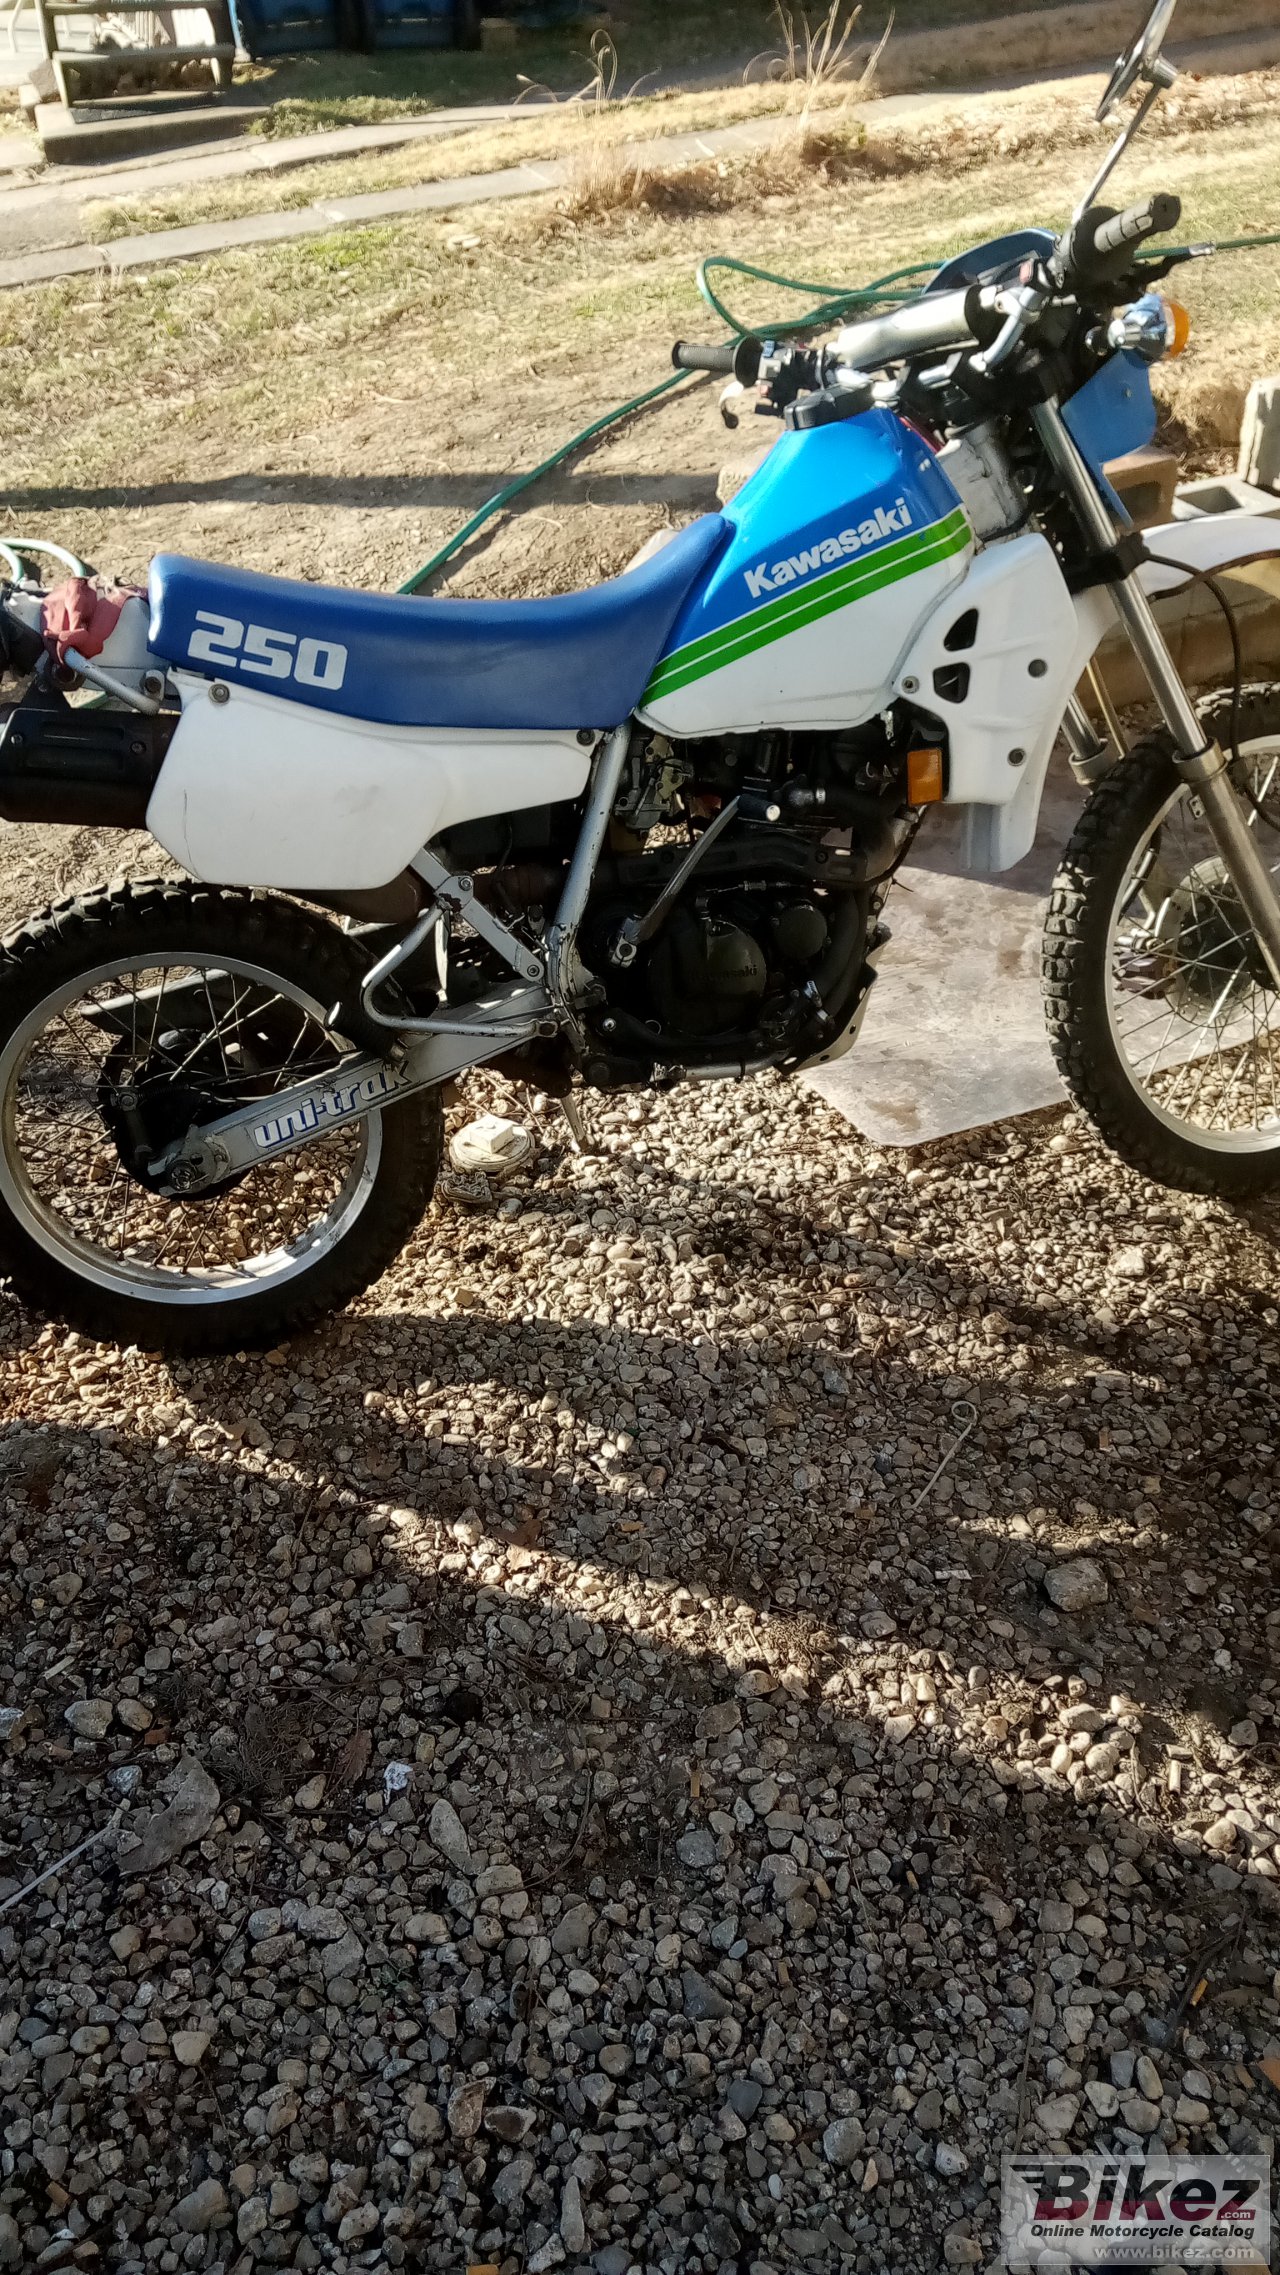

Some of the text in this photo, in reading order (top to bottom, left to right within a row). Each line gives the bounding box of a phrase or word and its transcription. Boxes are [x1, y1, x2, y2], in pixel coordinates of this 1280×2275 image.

[743, 496, 913, 599] Kawasaki
[187, 610, 348, 691] 250
[253, 1061, 412, 1148] uni-trak
